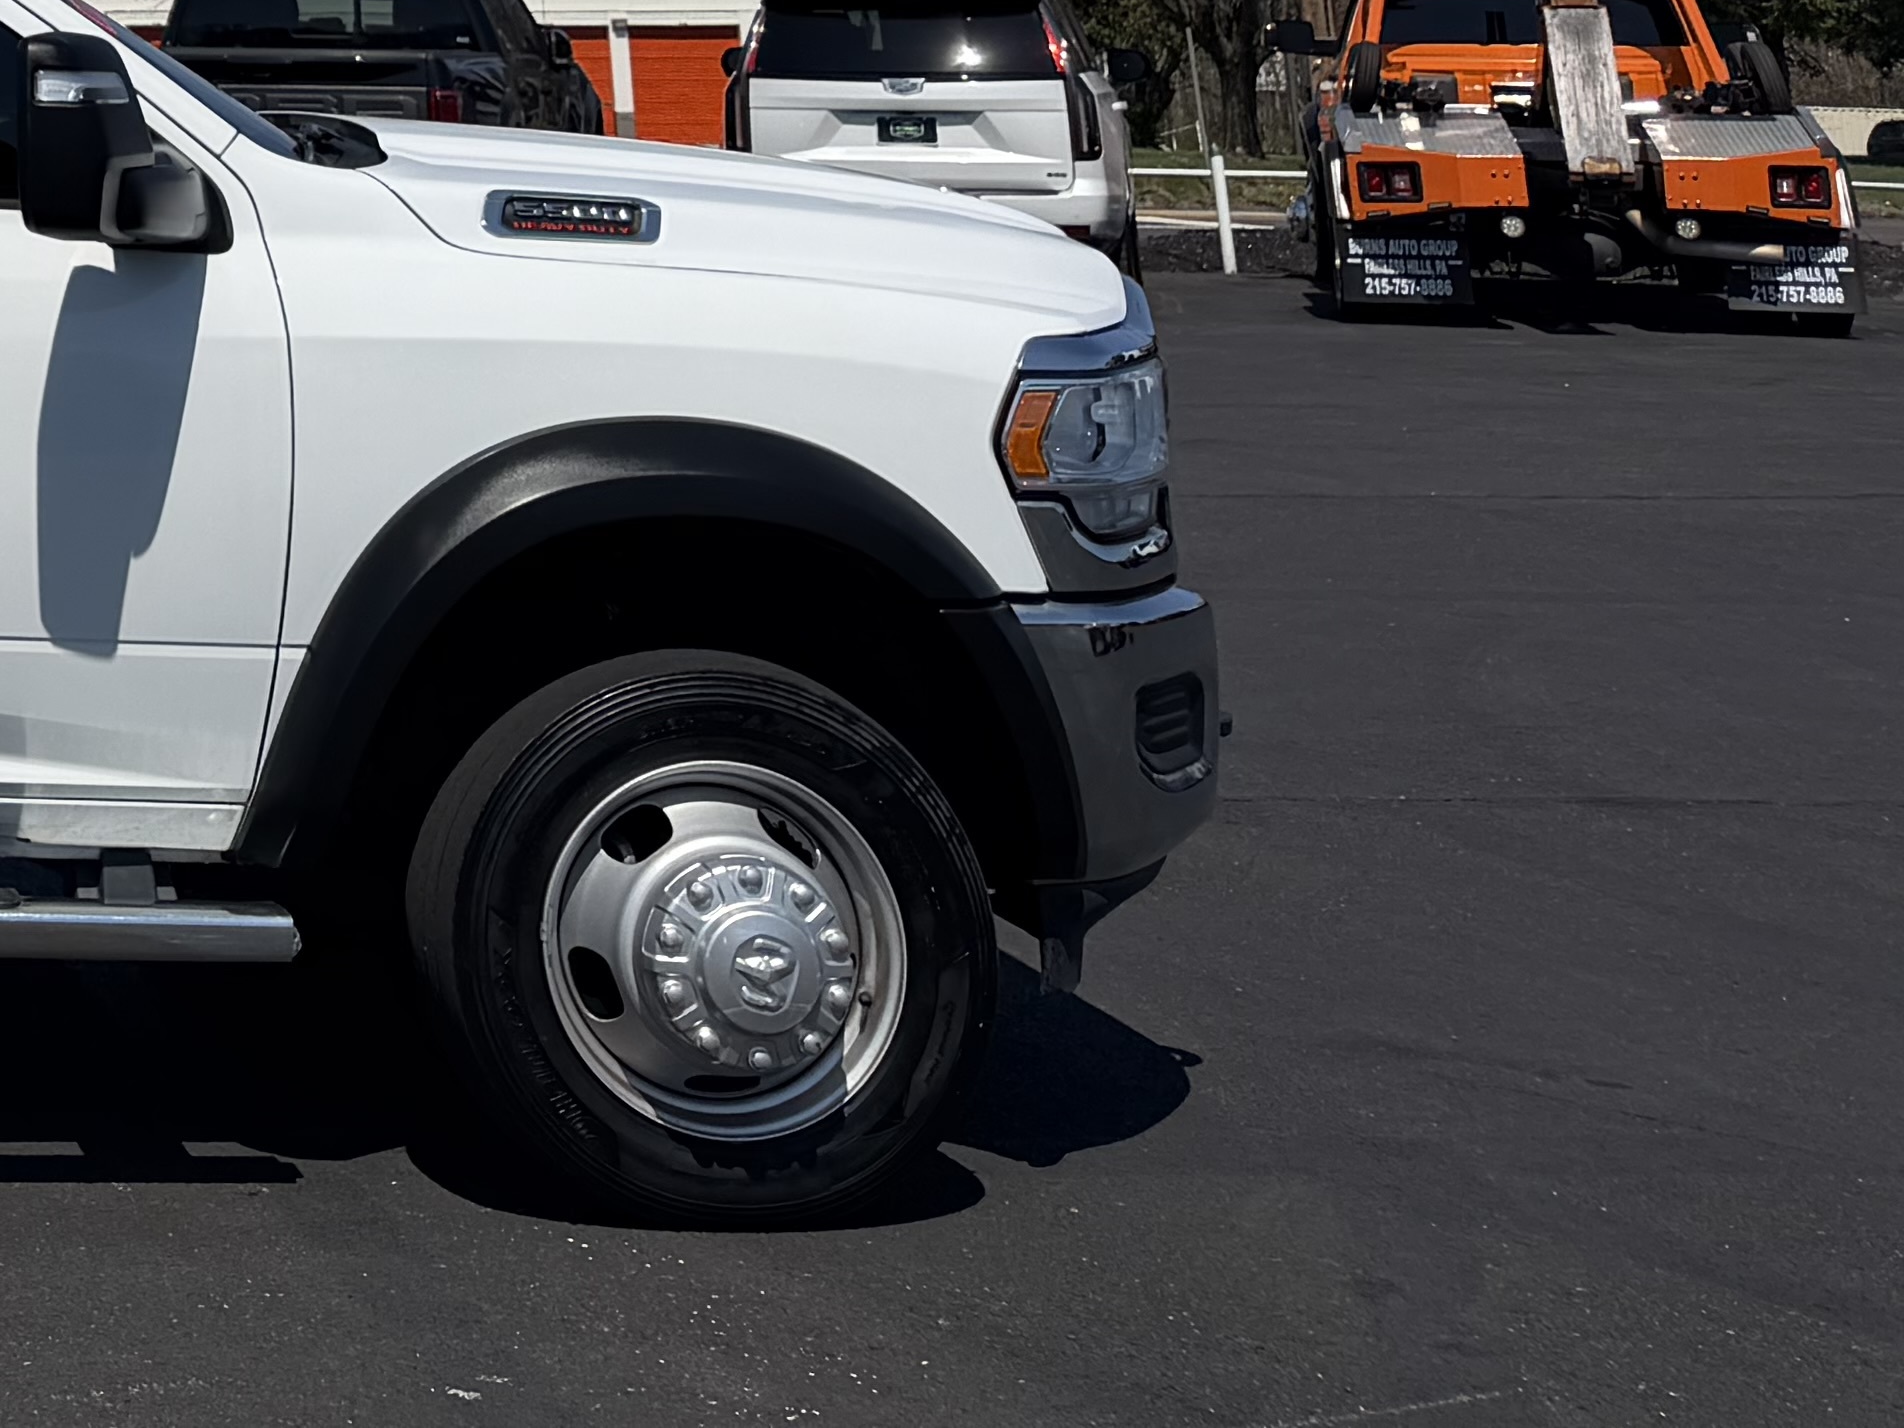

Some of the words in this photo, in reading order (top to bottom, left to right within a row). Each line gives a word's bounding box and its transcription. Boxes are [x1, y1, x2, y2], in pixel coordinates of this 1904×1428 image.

[1388, 239, 1419, 256] AUTO
[1420, 239, 1458, 256] GROUP
[1807, 246, 1849, 263] GROUP
[1435, 259, 1448, 276] PA
[1824, 267, 1840, 284] PA
